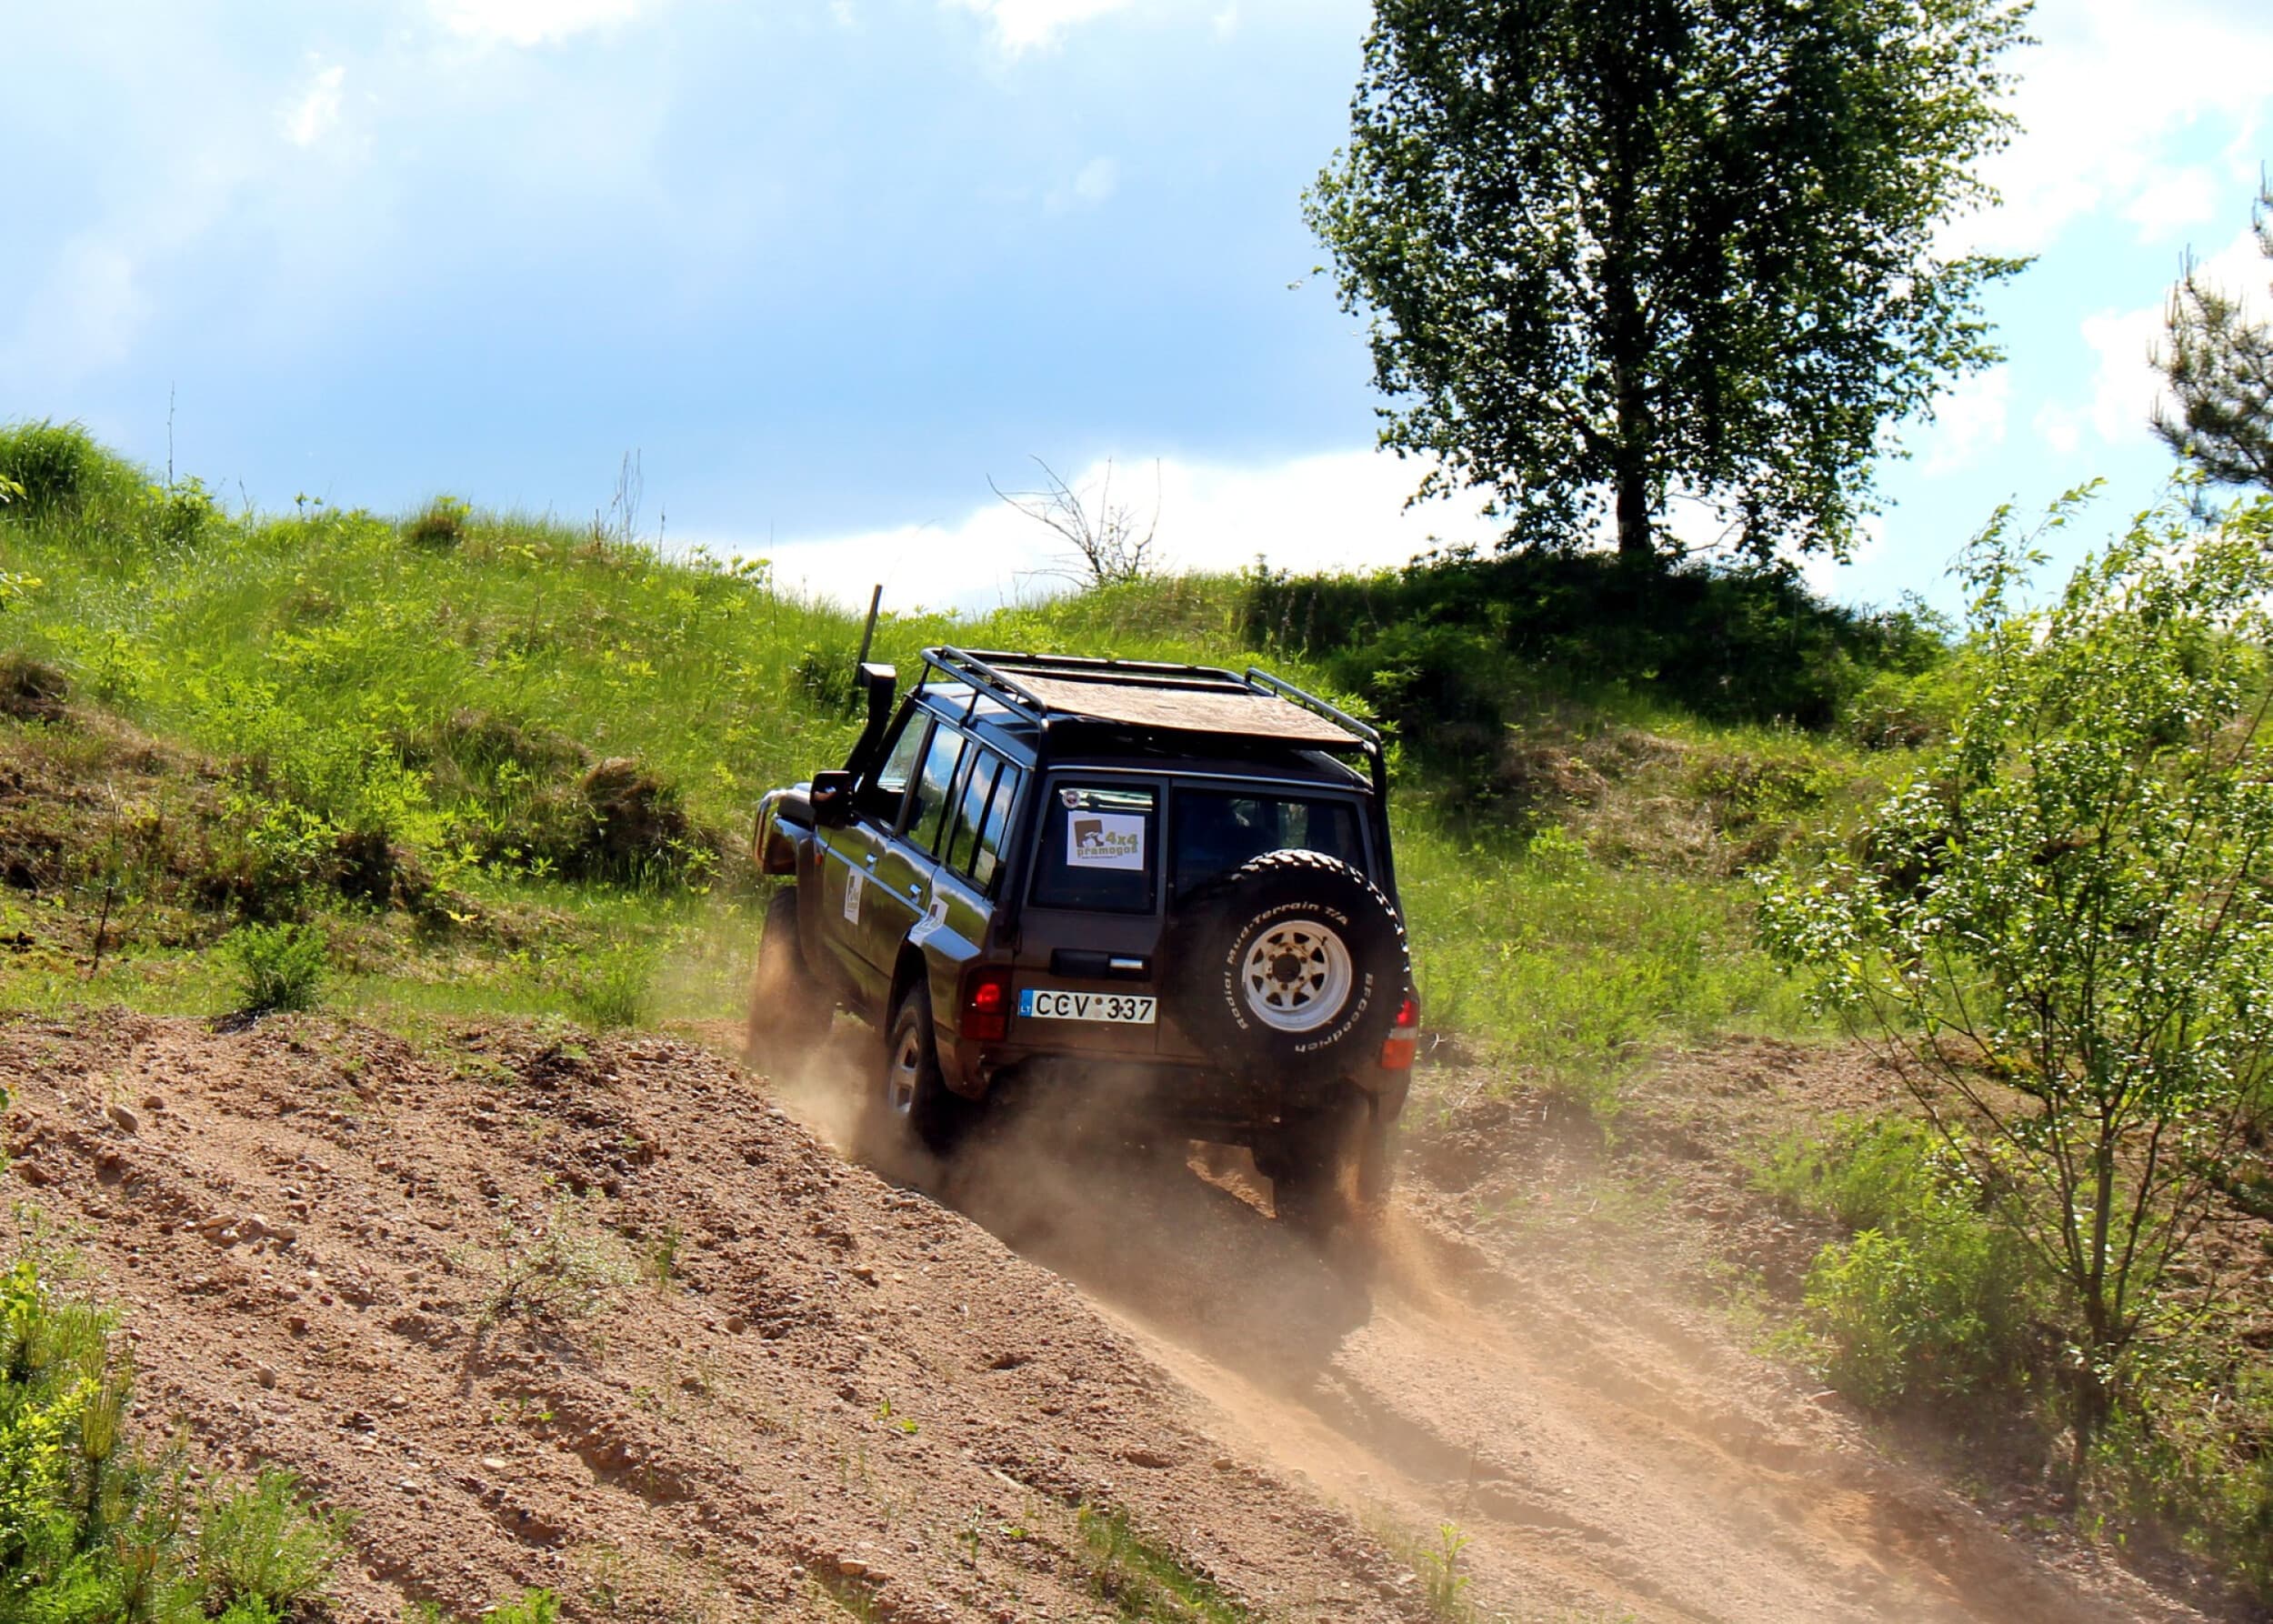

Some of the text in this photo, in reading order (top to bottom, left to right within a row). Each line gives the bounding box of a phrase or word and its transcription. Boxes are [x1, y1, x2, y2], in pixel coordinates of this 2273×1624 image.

[1105, 831, 1138, 847] 4x4
[1076, 845, 1138, 857] pramogos
[1224, 901, 1350, 1030] Radial Mud-Terrain T/A
[1020, 1005, 1031, 1013] LT
[1106, 997, 1153, 1021] 337
[1295, 972, 1375, 1053] BFGoodrich
